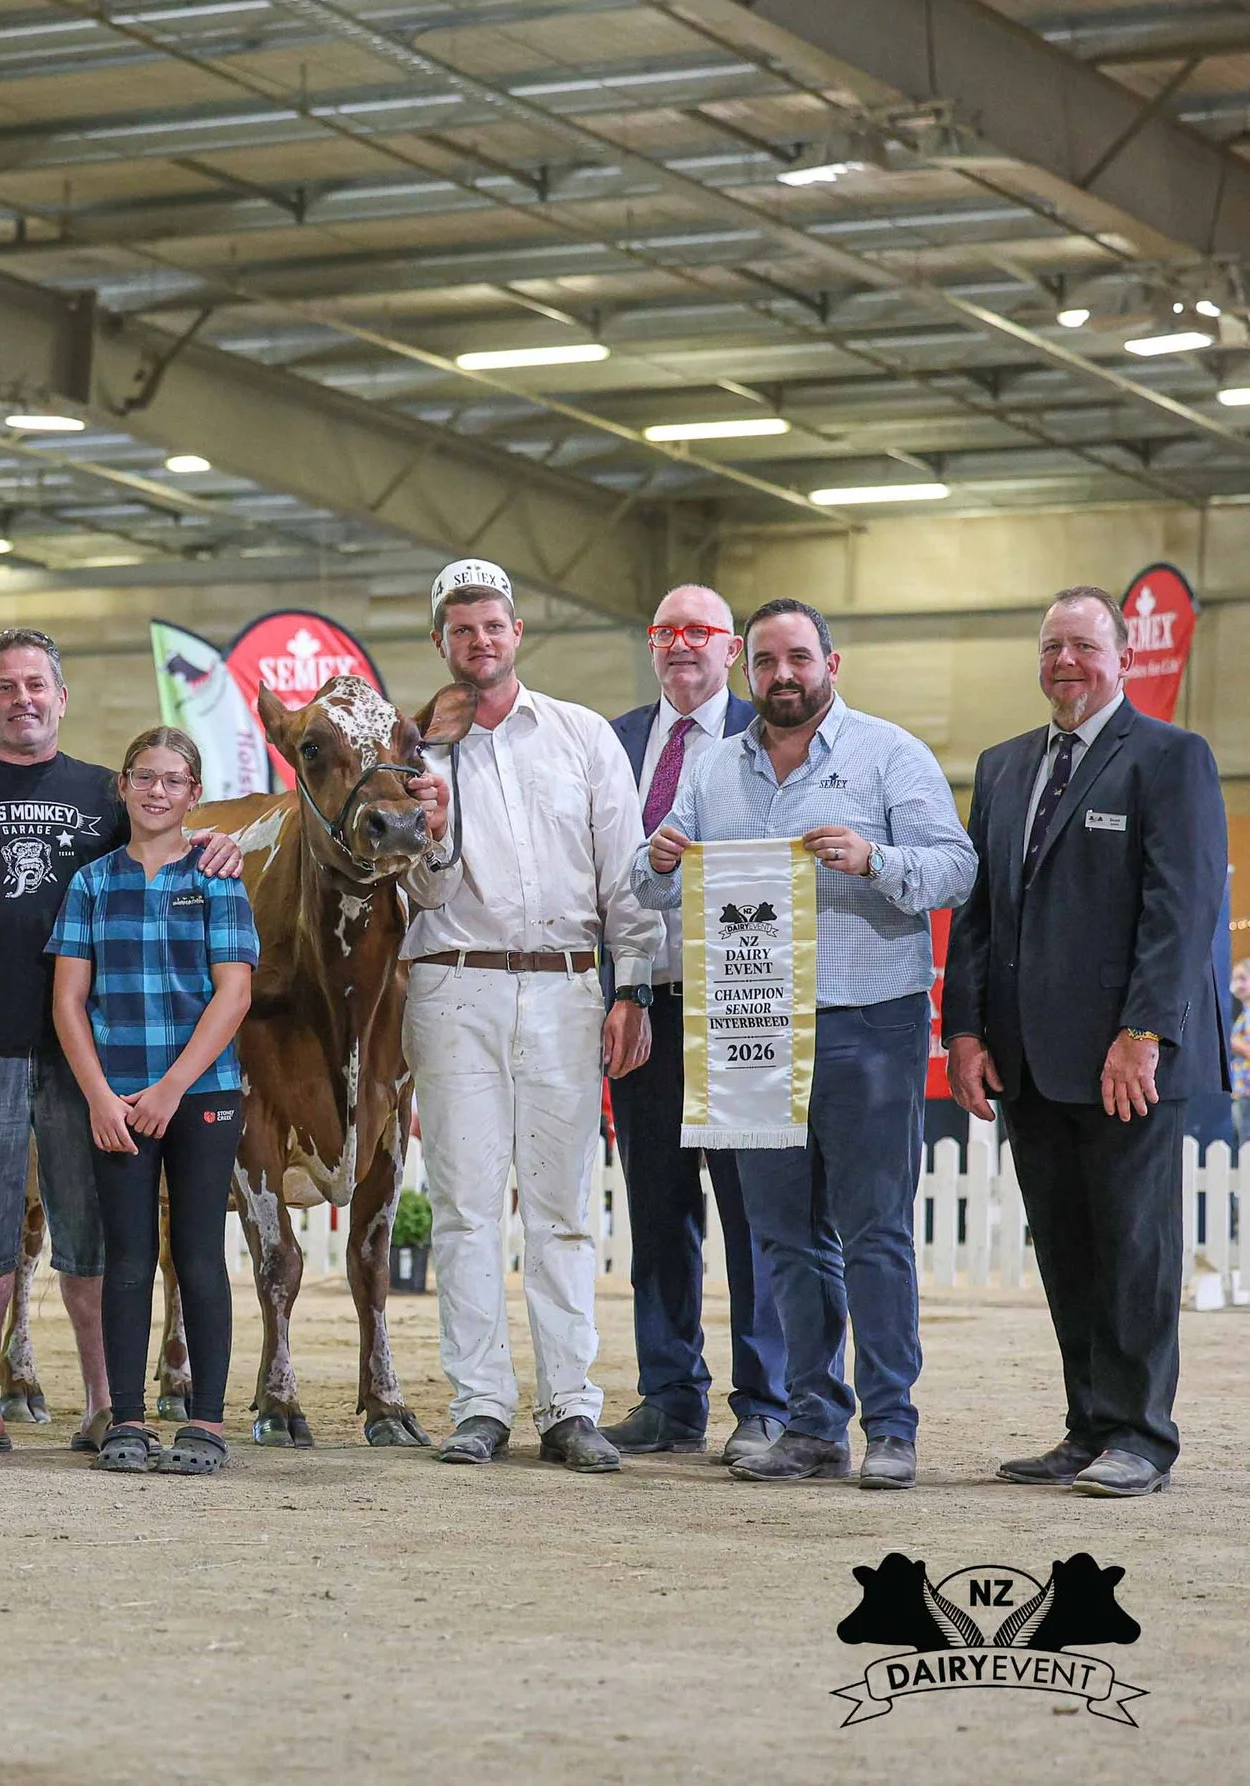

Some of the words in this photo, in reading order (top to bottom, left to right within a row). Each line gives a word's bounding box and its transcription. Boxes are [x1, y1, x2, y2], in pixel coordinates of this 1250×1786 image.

[1125, 612, 1177, 652] EMEX
[258, 655, 357, 691] SEMEX
[819, 779, 848, 789] SEMEX
[10, 804, 75, 824] MONKEY
[2, 826, 52, 835] GARAGE
[739, 935, 759, 947] NZ
[726, 948, 771, 961] DAIRY
[724, 962, 773, 975] EVENT
[714, 987, 784, 1001] CHAMPION
[725, 1002, 772, 1015] SENIOR
[710, 1015, 789, 1029] INTERBREED
[727, 1043, 775, 1061] 2026
